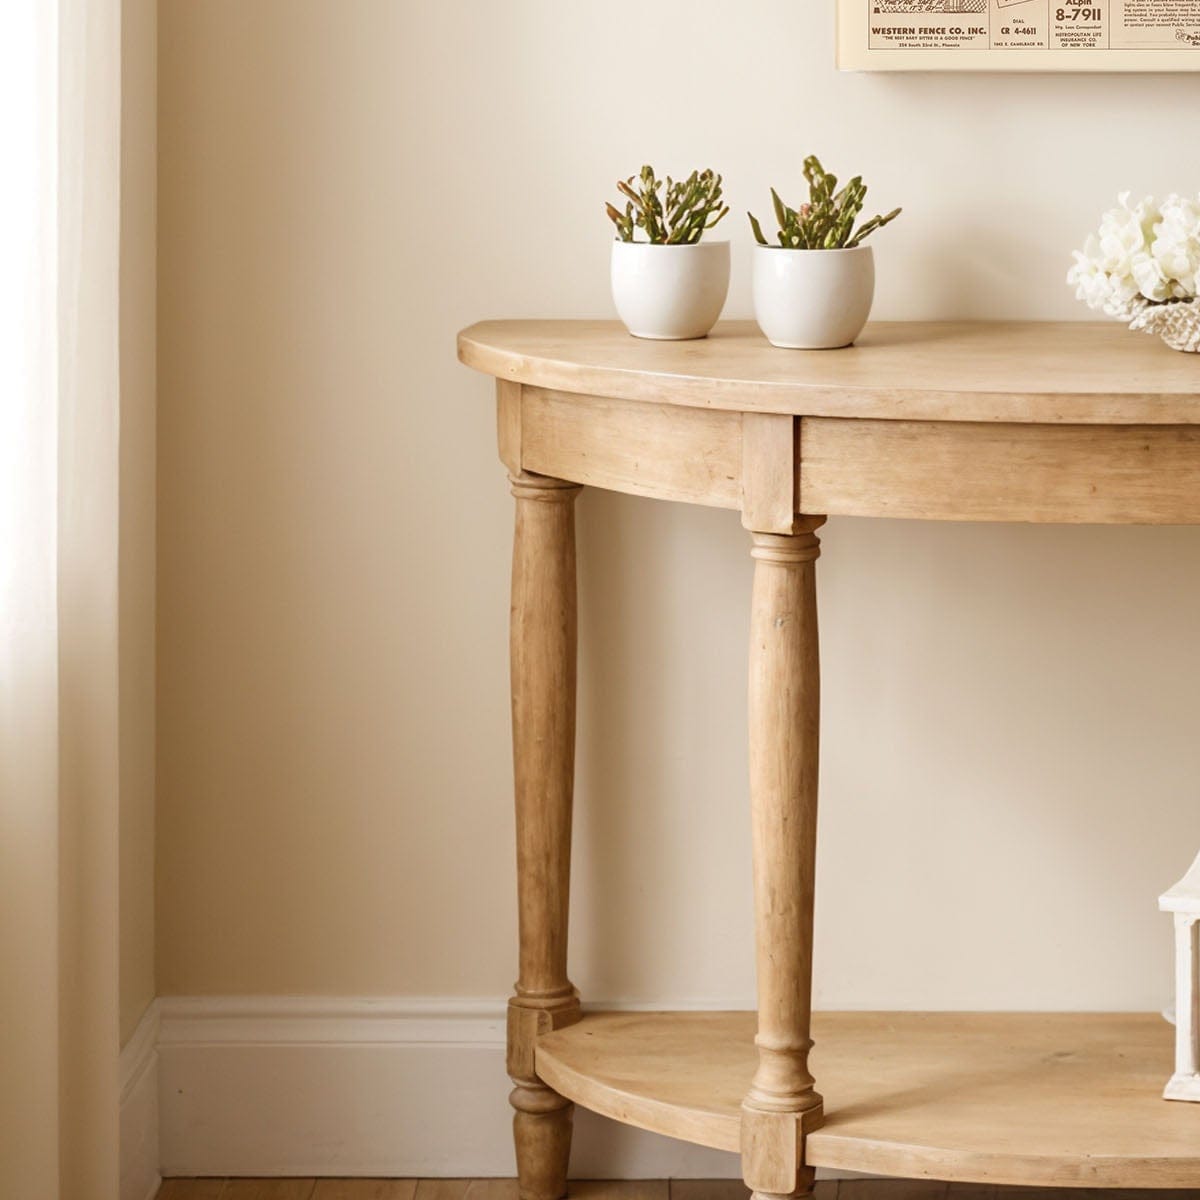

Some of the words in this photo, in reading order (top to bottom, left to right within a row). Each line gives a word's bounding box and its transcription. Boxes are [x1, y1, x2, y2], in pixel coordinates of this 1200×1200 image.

[1055, 9, 1101, 21] 8-7911
[871, 27, 915, 35] WESTERN
[918, 27, 947, 35] FENCE
[949, 27, 965, 35] CO.
[968, 27, 987, 35] INC.
